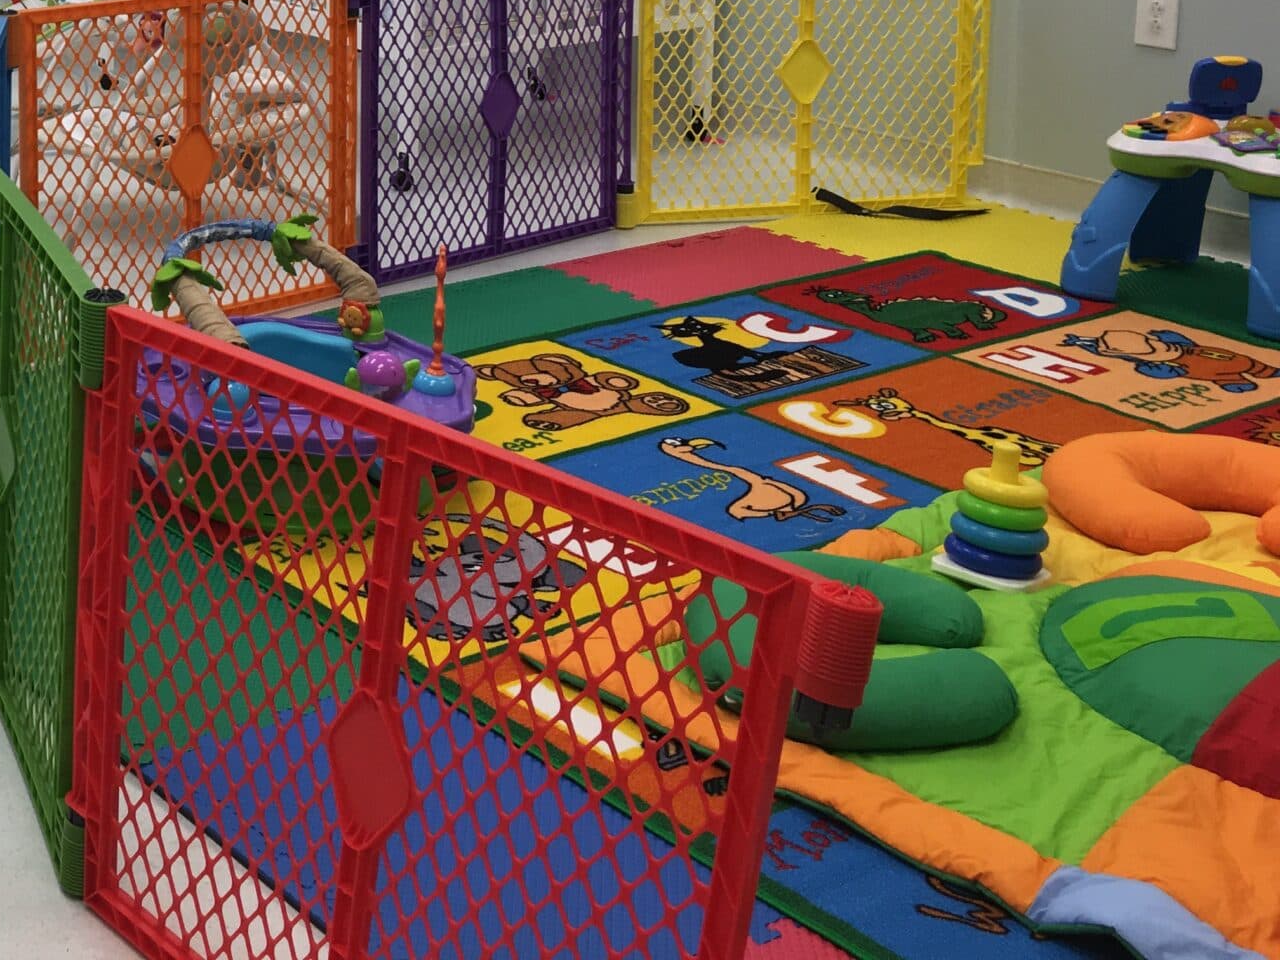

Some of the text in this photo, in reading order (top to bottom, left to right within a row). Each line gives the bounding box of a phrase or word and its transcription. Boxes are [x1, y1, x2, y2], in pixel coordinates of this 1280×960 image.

[970, 286, 1076, 319] D
[737, 312, 848, 344] C
[980, 345, 1109, 384] H
[1119, 383, 1222, 413] Hippo
[779, 401, 883, 438] G
[502, 431, 563, 452] ear
[630, 471, 732, 506] amingo
[775, 452, 904, 508] F
